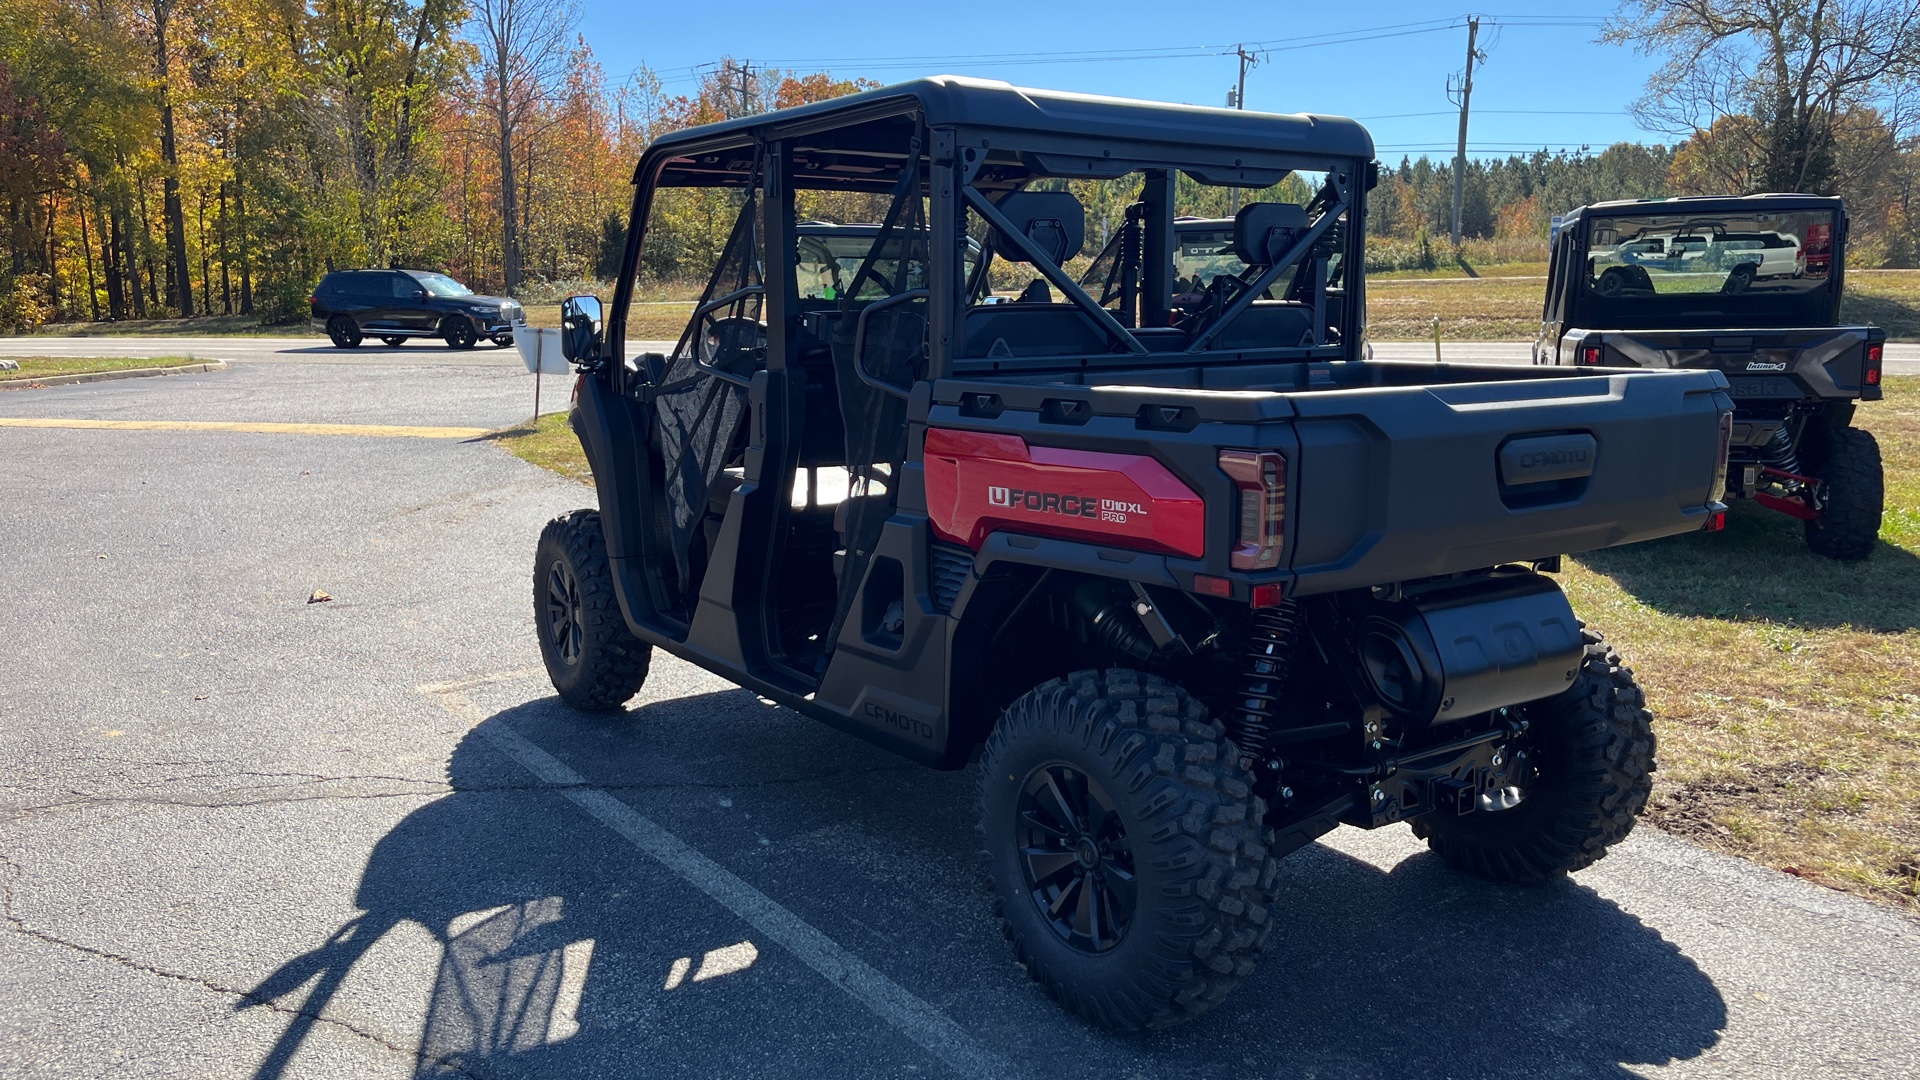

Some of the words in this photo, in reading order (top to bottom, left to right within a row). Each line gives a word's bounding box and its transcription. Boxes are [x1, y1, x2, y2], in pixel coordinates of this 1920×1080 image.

[1520, 449, 1587, 468] CFMOTO
[1101, 511, 1126, 523] PRO
[864, 701, 933, 740] CFMOTO
